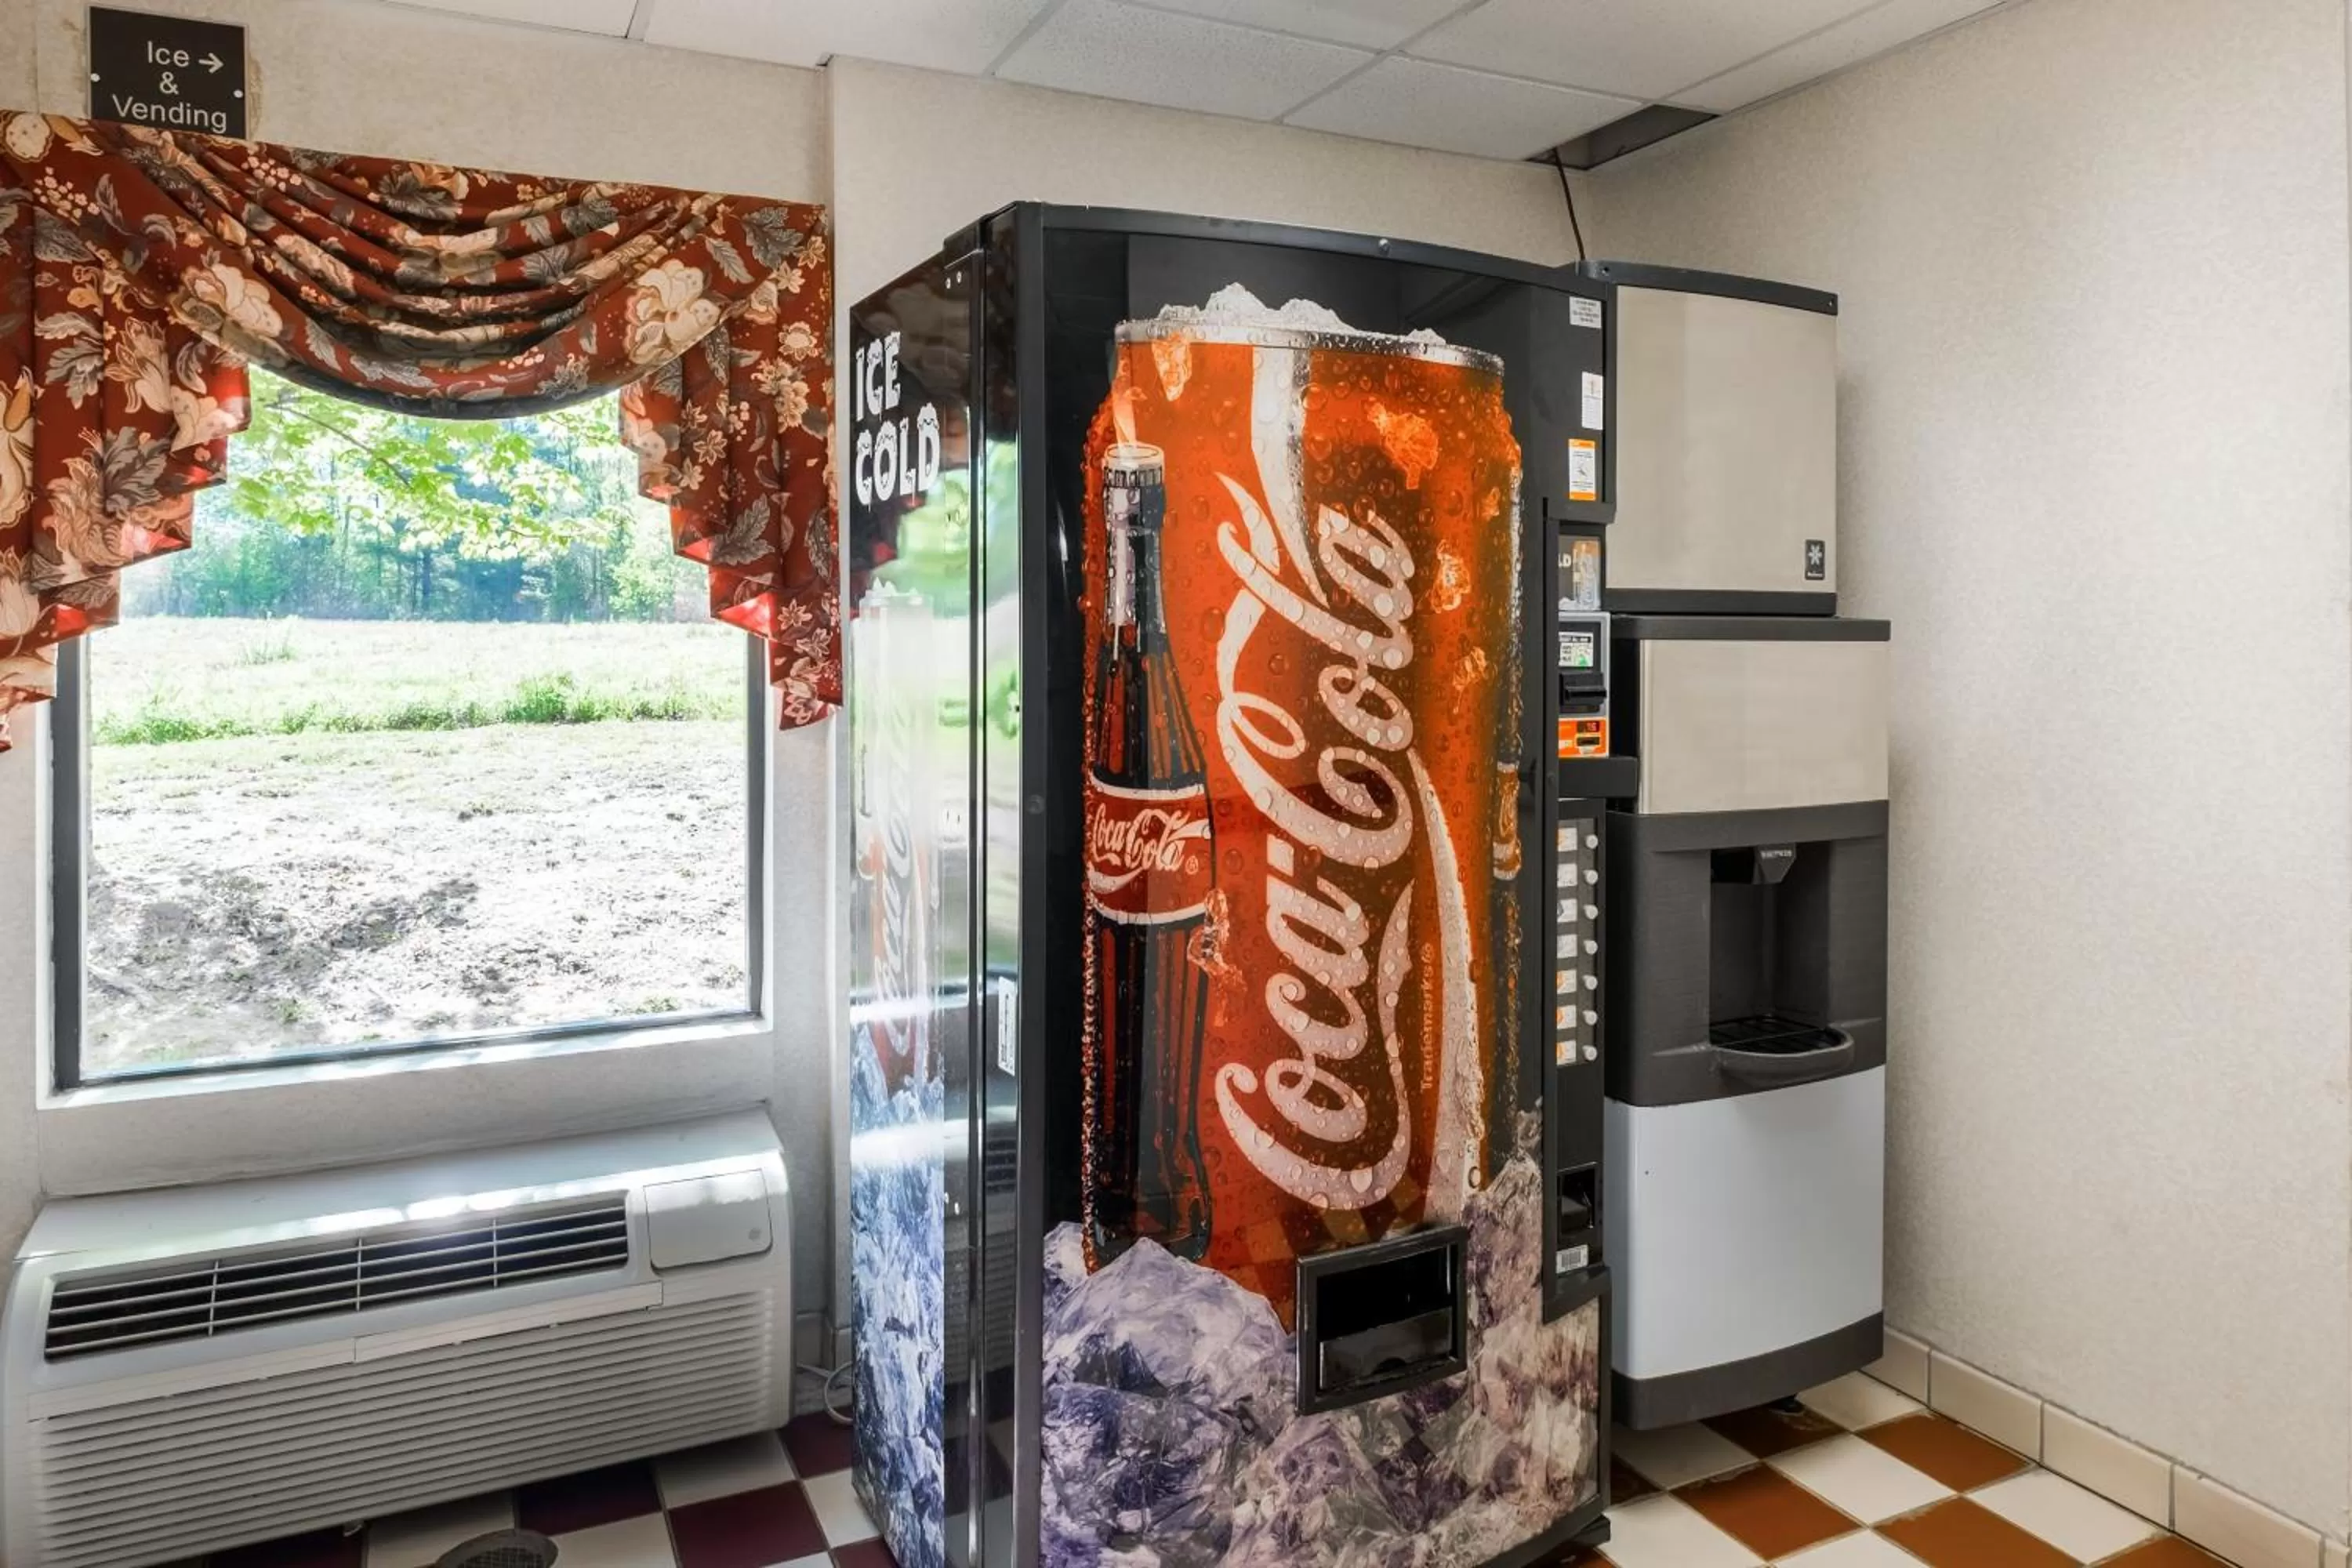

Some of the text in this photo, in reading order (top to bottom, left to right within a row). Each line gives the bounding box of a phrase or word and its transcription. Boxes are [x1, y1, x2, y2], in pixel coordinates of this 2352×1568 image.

[147, 41, 190, 67] Ice
[159, 71, 180, 95] &
[112, 93, 227, 133] Vending
[855, 331, 901, 422] ICE
[855, 401, 940, 511] COLD
[1092, 802, 1191, 872] Coca-Cola
[1215, 471, 1414, 1210] Coca-Cola
